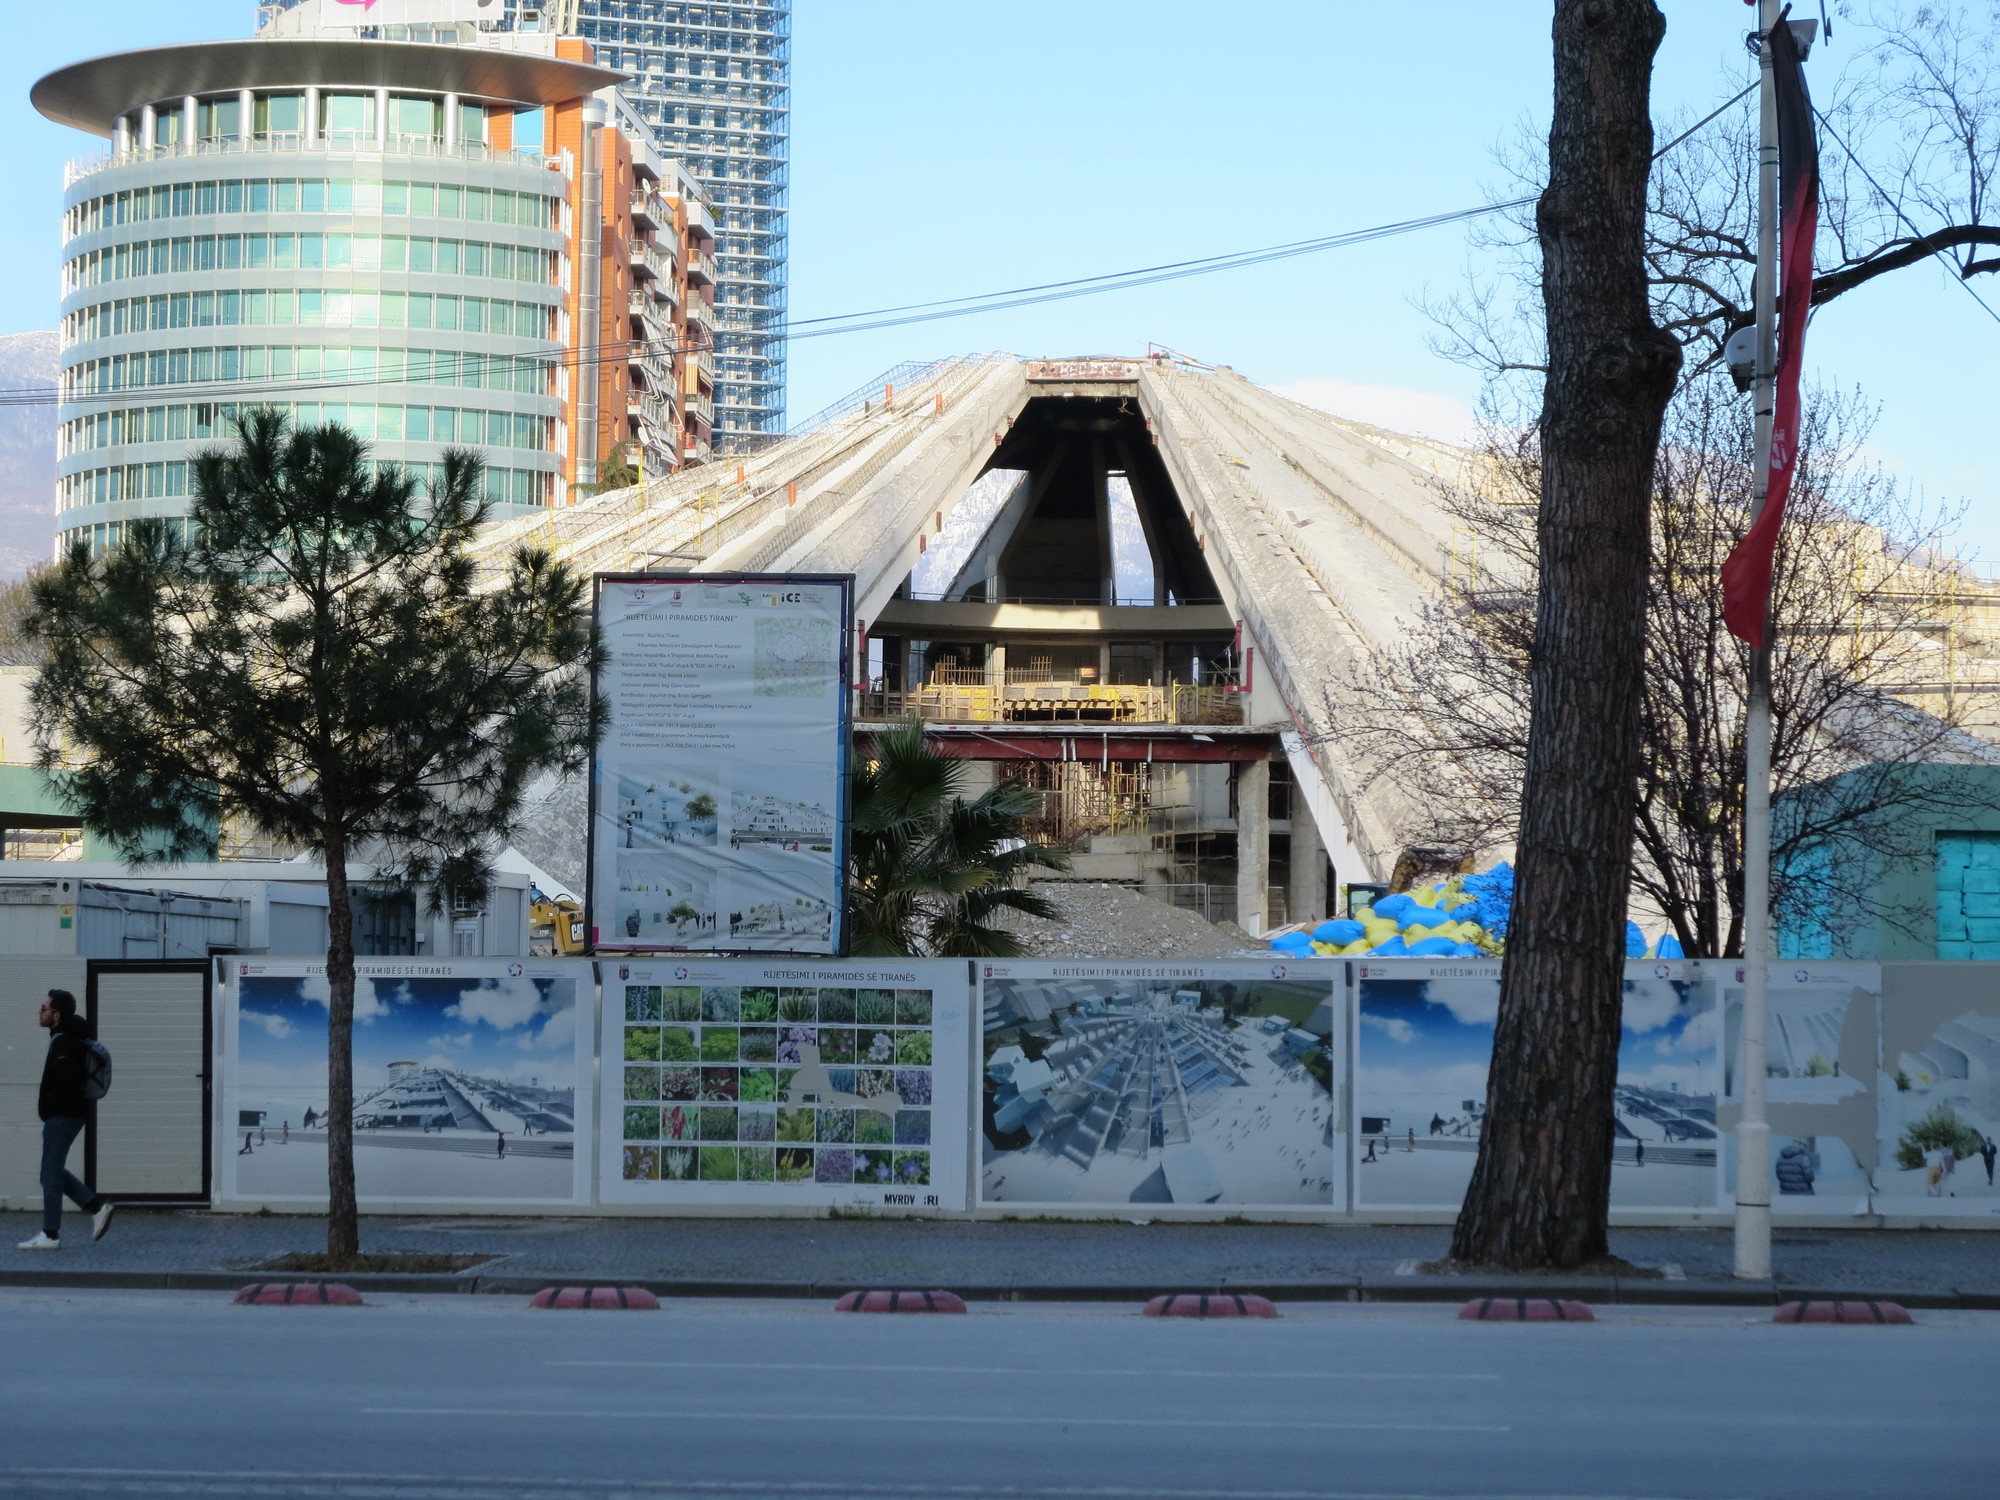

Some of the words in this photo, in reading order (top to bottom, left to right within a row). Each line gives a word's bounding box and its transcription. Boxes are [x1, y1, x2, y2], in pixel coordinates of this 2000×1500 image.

[763, 969, 810, 980] RIJETËSIMI
[812, 971, 816, 979] I
[818, 970, 865, 981] PIRAMIDËS
[867, 971, 878, 981] SË
[880, 972, 916, 982] TIRANËS
[1053, 967, 1099, 976] RIJETËSIMI
[1106, 967, 1152, 977] PIRAMIDËS
[1155, 967, 1165, 977] SË
[1169, 968, 1205, 977] TIRANËS
[884, 1194, 915, 1205] MVRDV
